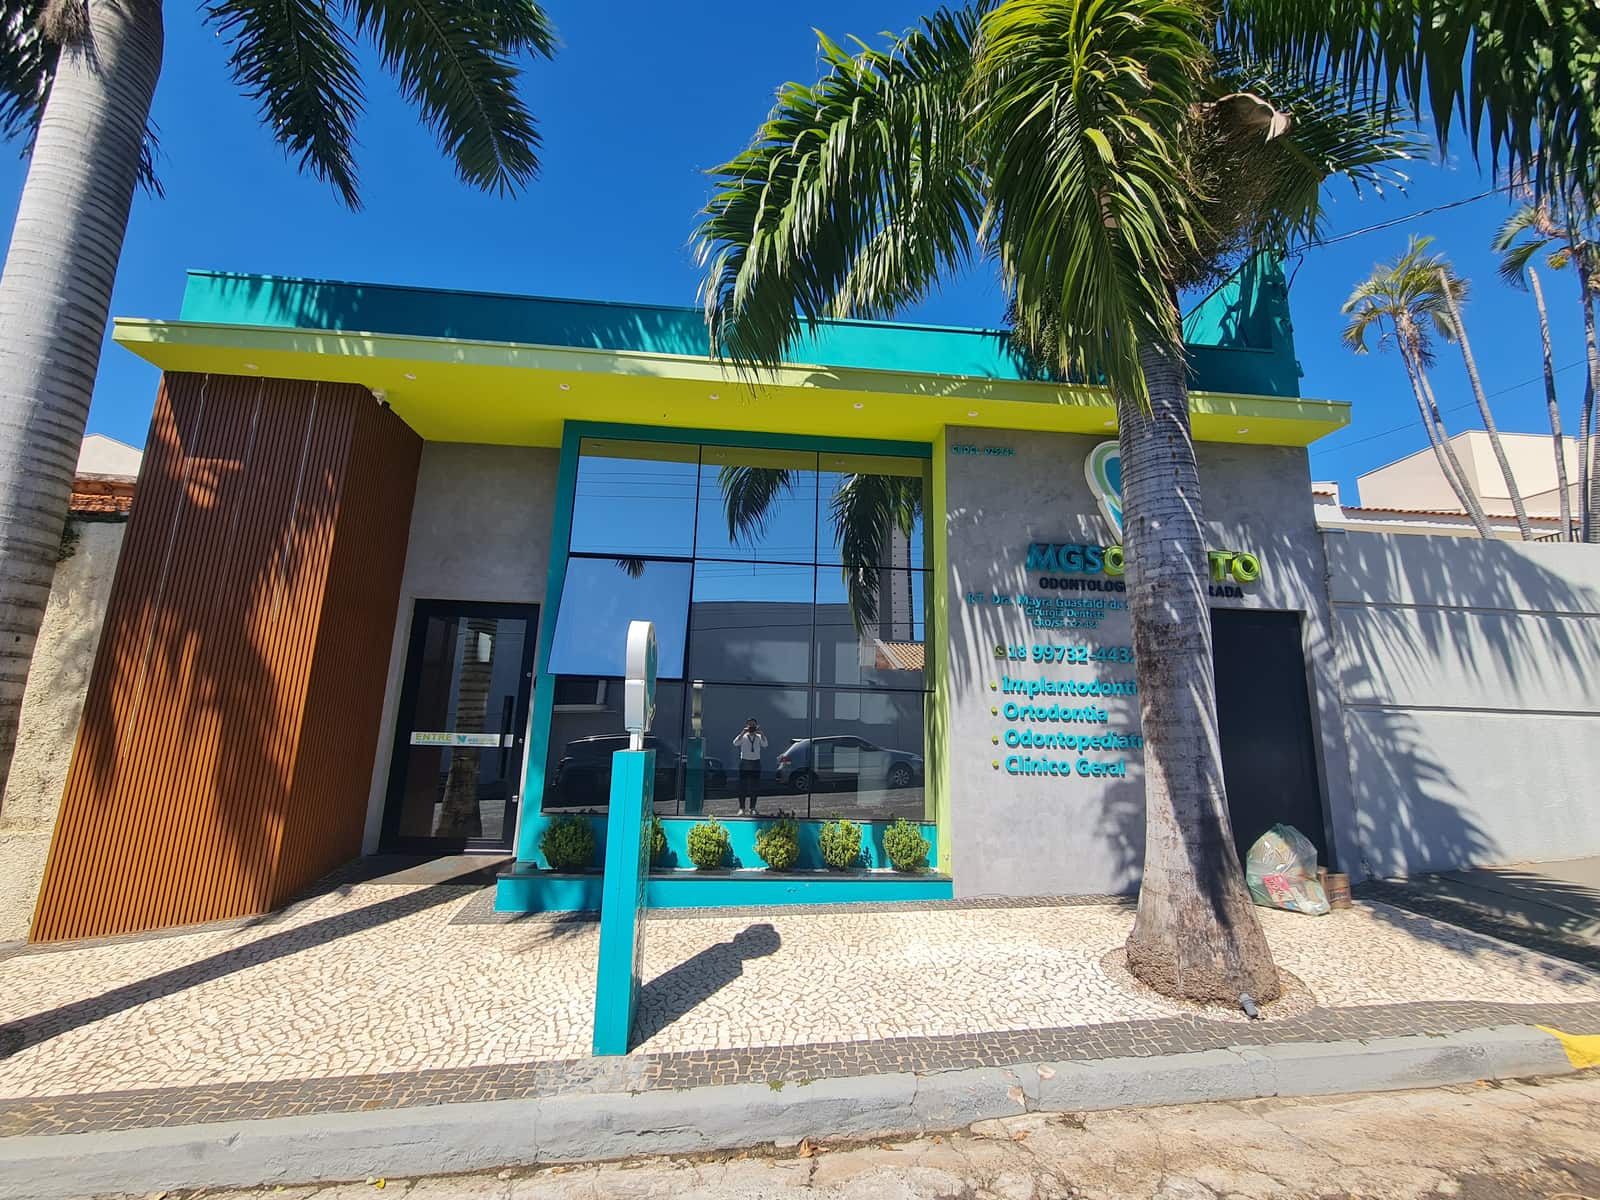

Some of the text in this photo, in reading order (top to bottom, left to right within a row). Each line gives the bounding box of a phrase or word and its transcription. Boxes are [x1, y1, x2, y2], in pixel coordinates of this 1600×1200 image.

[1026, 543, 1261, 583] MGSOTO
[1039, 577, 1126, 592] ODONTOLOGI
[1008, 644, 1027, 660] 18
[1001, 675, 1137, 700] Implantodonti
[1003, 702, 1109, 723] Ortodontia
[415, 733, 452, 741] ENTRE
[1004, 727, 1143, 754] Odontopediatr
[1075, 756, 1126, 777] Geral
